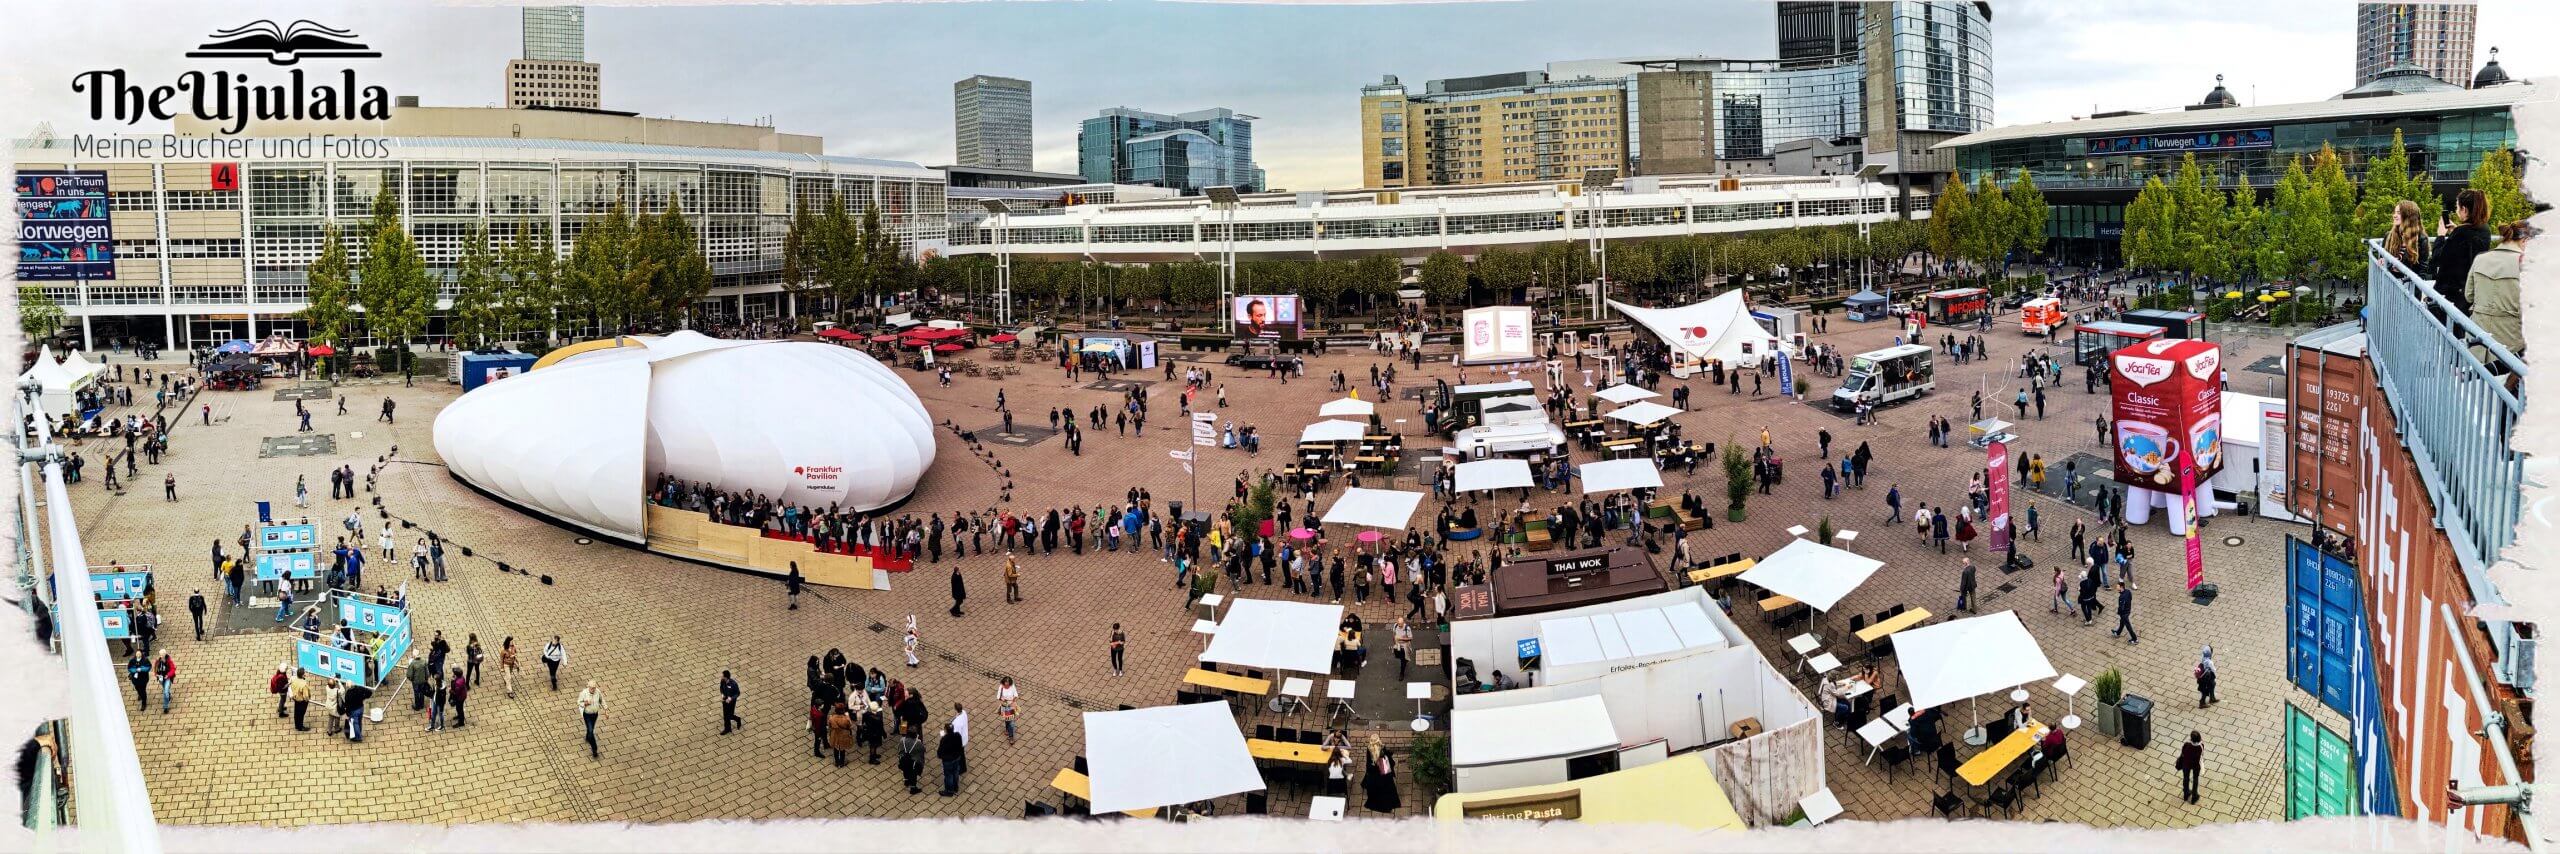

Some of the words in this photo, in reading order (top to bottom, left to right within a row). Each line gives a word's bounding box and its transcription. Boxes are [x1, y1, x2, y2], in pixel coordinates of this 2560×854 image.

[2154, 137, 2195, 149] Norwegen
[55, 177, 73, 186] Der
[74, 177, 104, 186] Traum
[217, 165, 233, 187] 4
[56, 188, 65, 196] in
[67, 188, 85, 196] uns
[2127, 391, 2160, 406] Classic
[2198, 385, 2216, 401] Classic
[2326, 389, 2350, 403] 193725
[1554, 562, 1576, 572] THAI
[1579, 558, 1602, 569] WOK
[1460, 592, 1471, 610] WOK
